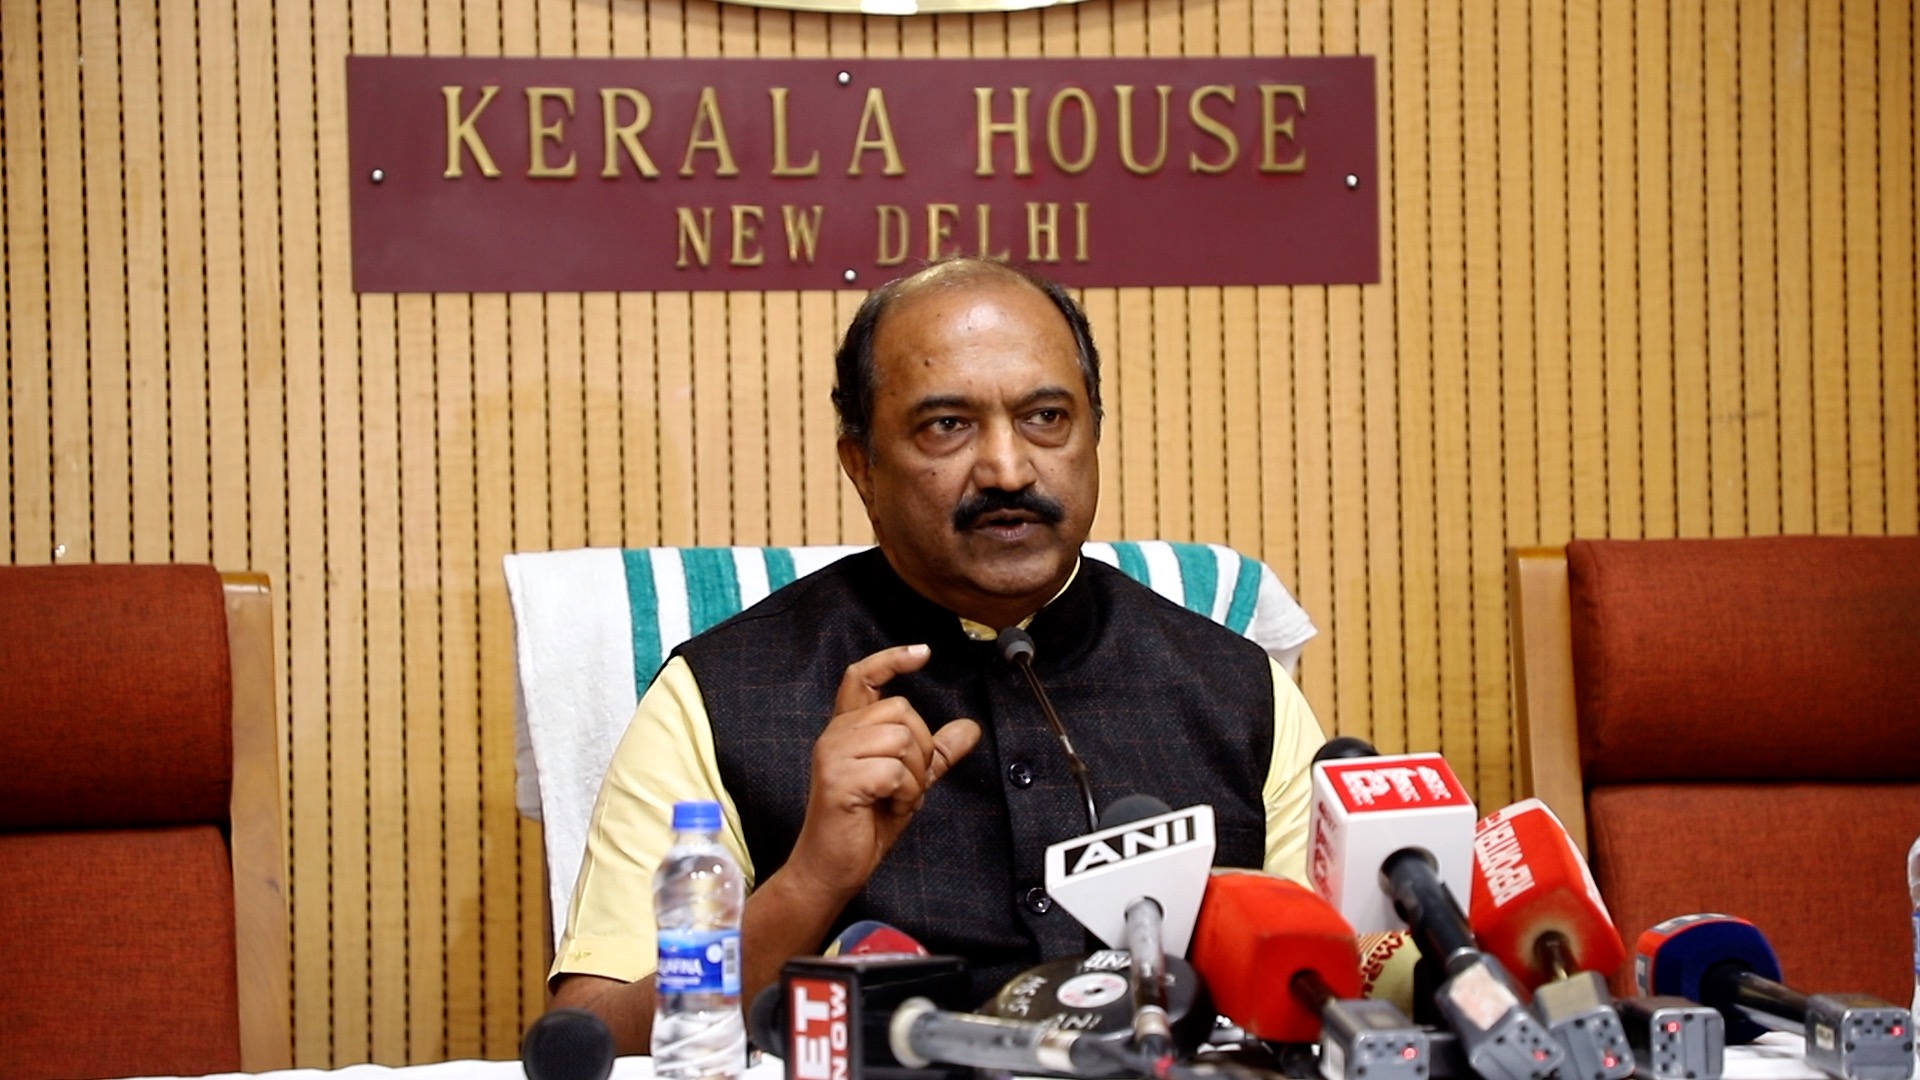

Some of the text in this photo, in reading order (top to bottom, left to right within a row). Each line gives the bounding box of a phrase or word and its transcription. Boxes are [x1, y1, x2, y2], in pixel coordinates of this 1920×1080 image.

[441, 84, 1308, 178] KERALA HOUSE
[676, 202, 1090, 268] NEW DELHI
[1340, 765, 1452, 806] PTI
[1072, 818, 1190, 874] ANI
[1474, 819, 1536, 908] REPORTER
[794, 986, 831, 1080] ET
[829, 982, 848, 1080] NOW
